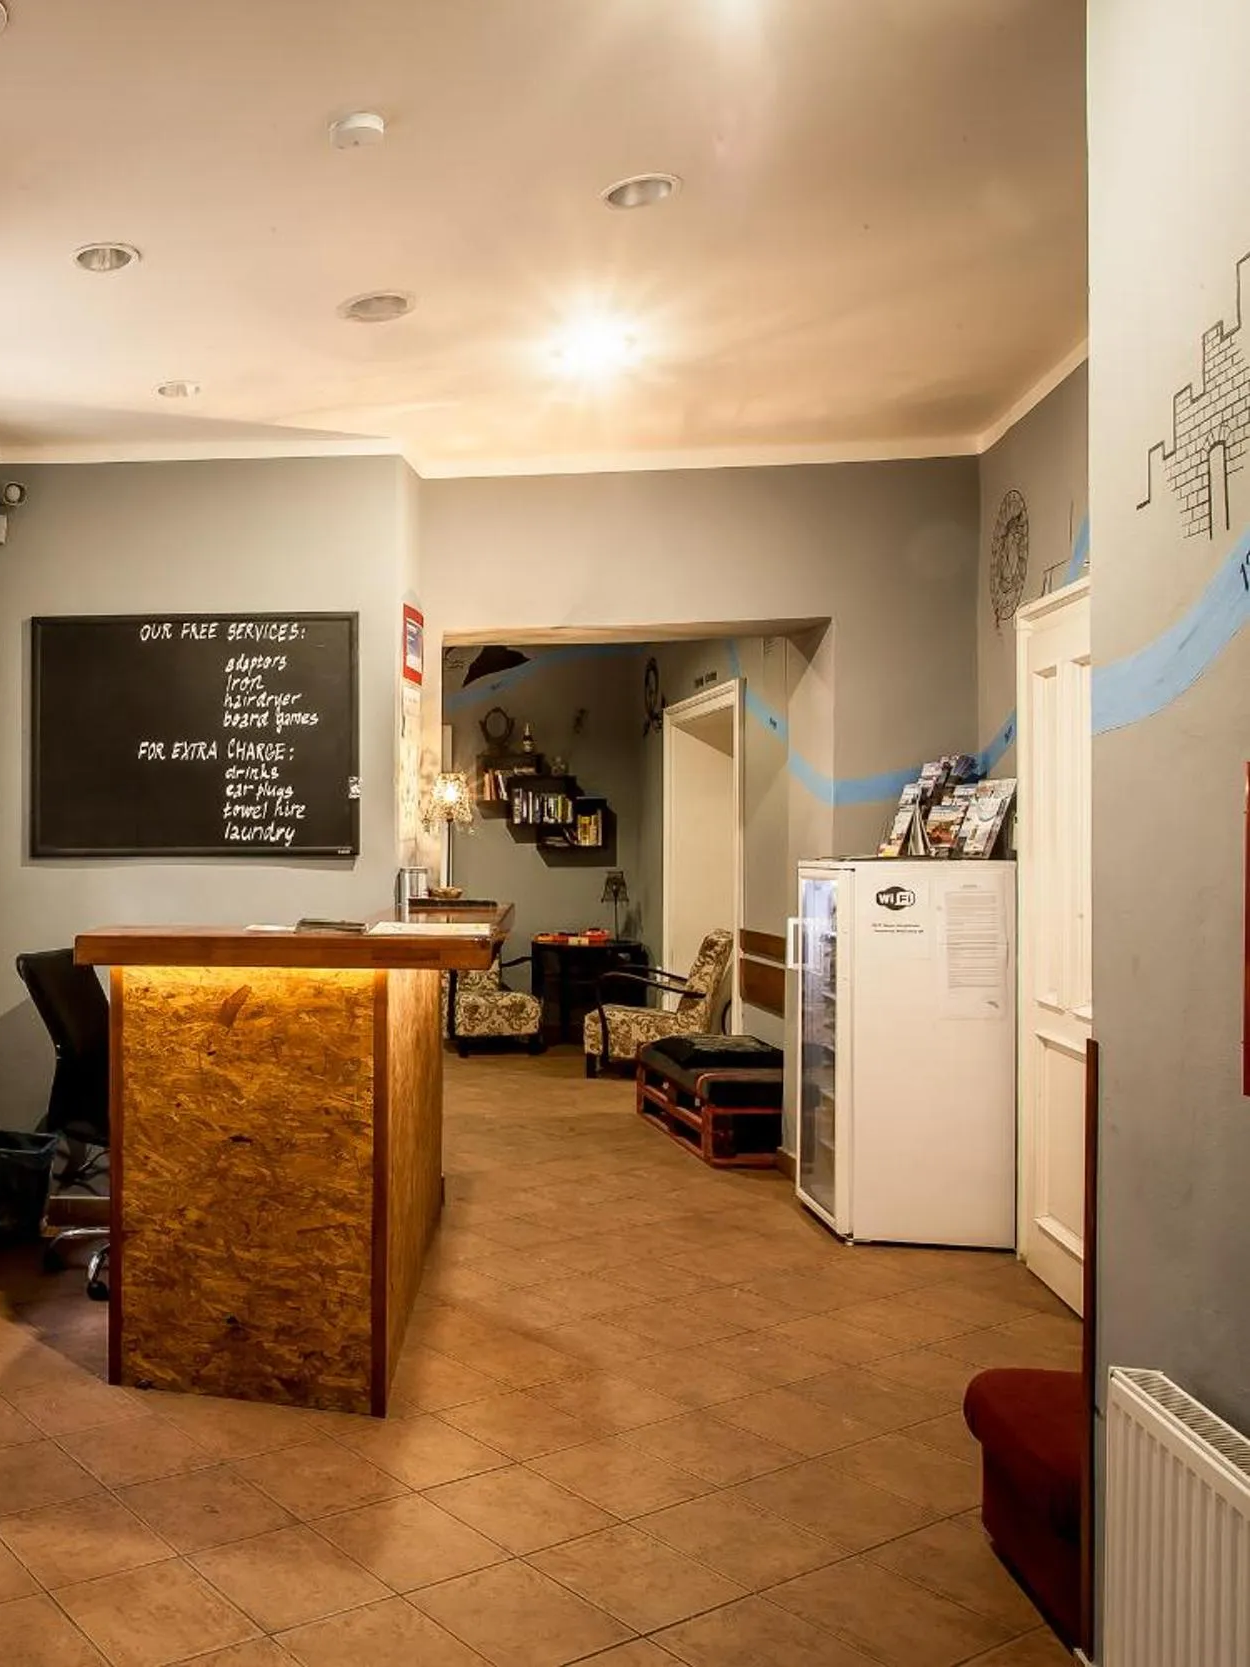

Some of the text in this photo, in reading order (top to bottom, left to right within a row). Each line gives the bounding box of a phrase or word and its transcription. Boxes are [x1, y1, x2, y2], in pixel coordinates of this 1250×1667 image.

[140, 622, 306, 642] OUR FREE SERVICES:
[225, 653, 287, 676] adaptors
[223, 691, 302, 715] hairdryer
[223, 710, 319, 733] board games
[137, 737, 295, 761] FOR EXTRA CHARGE:
[224, 763, 280, 780] drinks
[226, 780, 294, 801] ear plugs
[223, 796, 307, 819] towel hire
[224, 821, 296, 847] laundry
